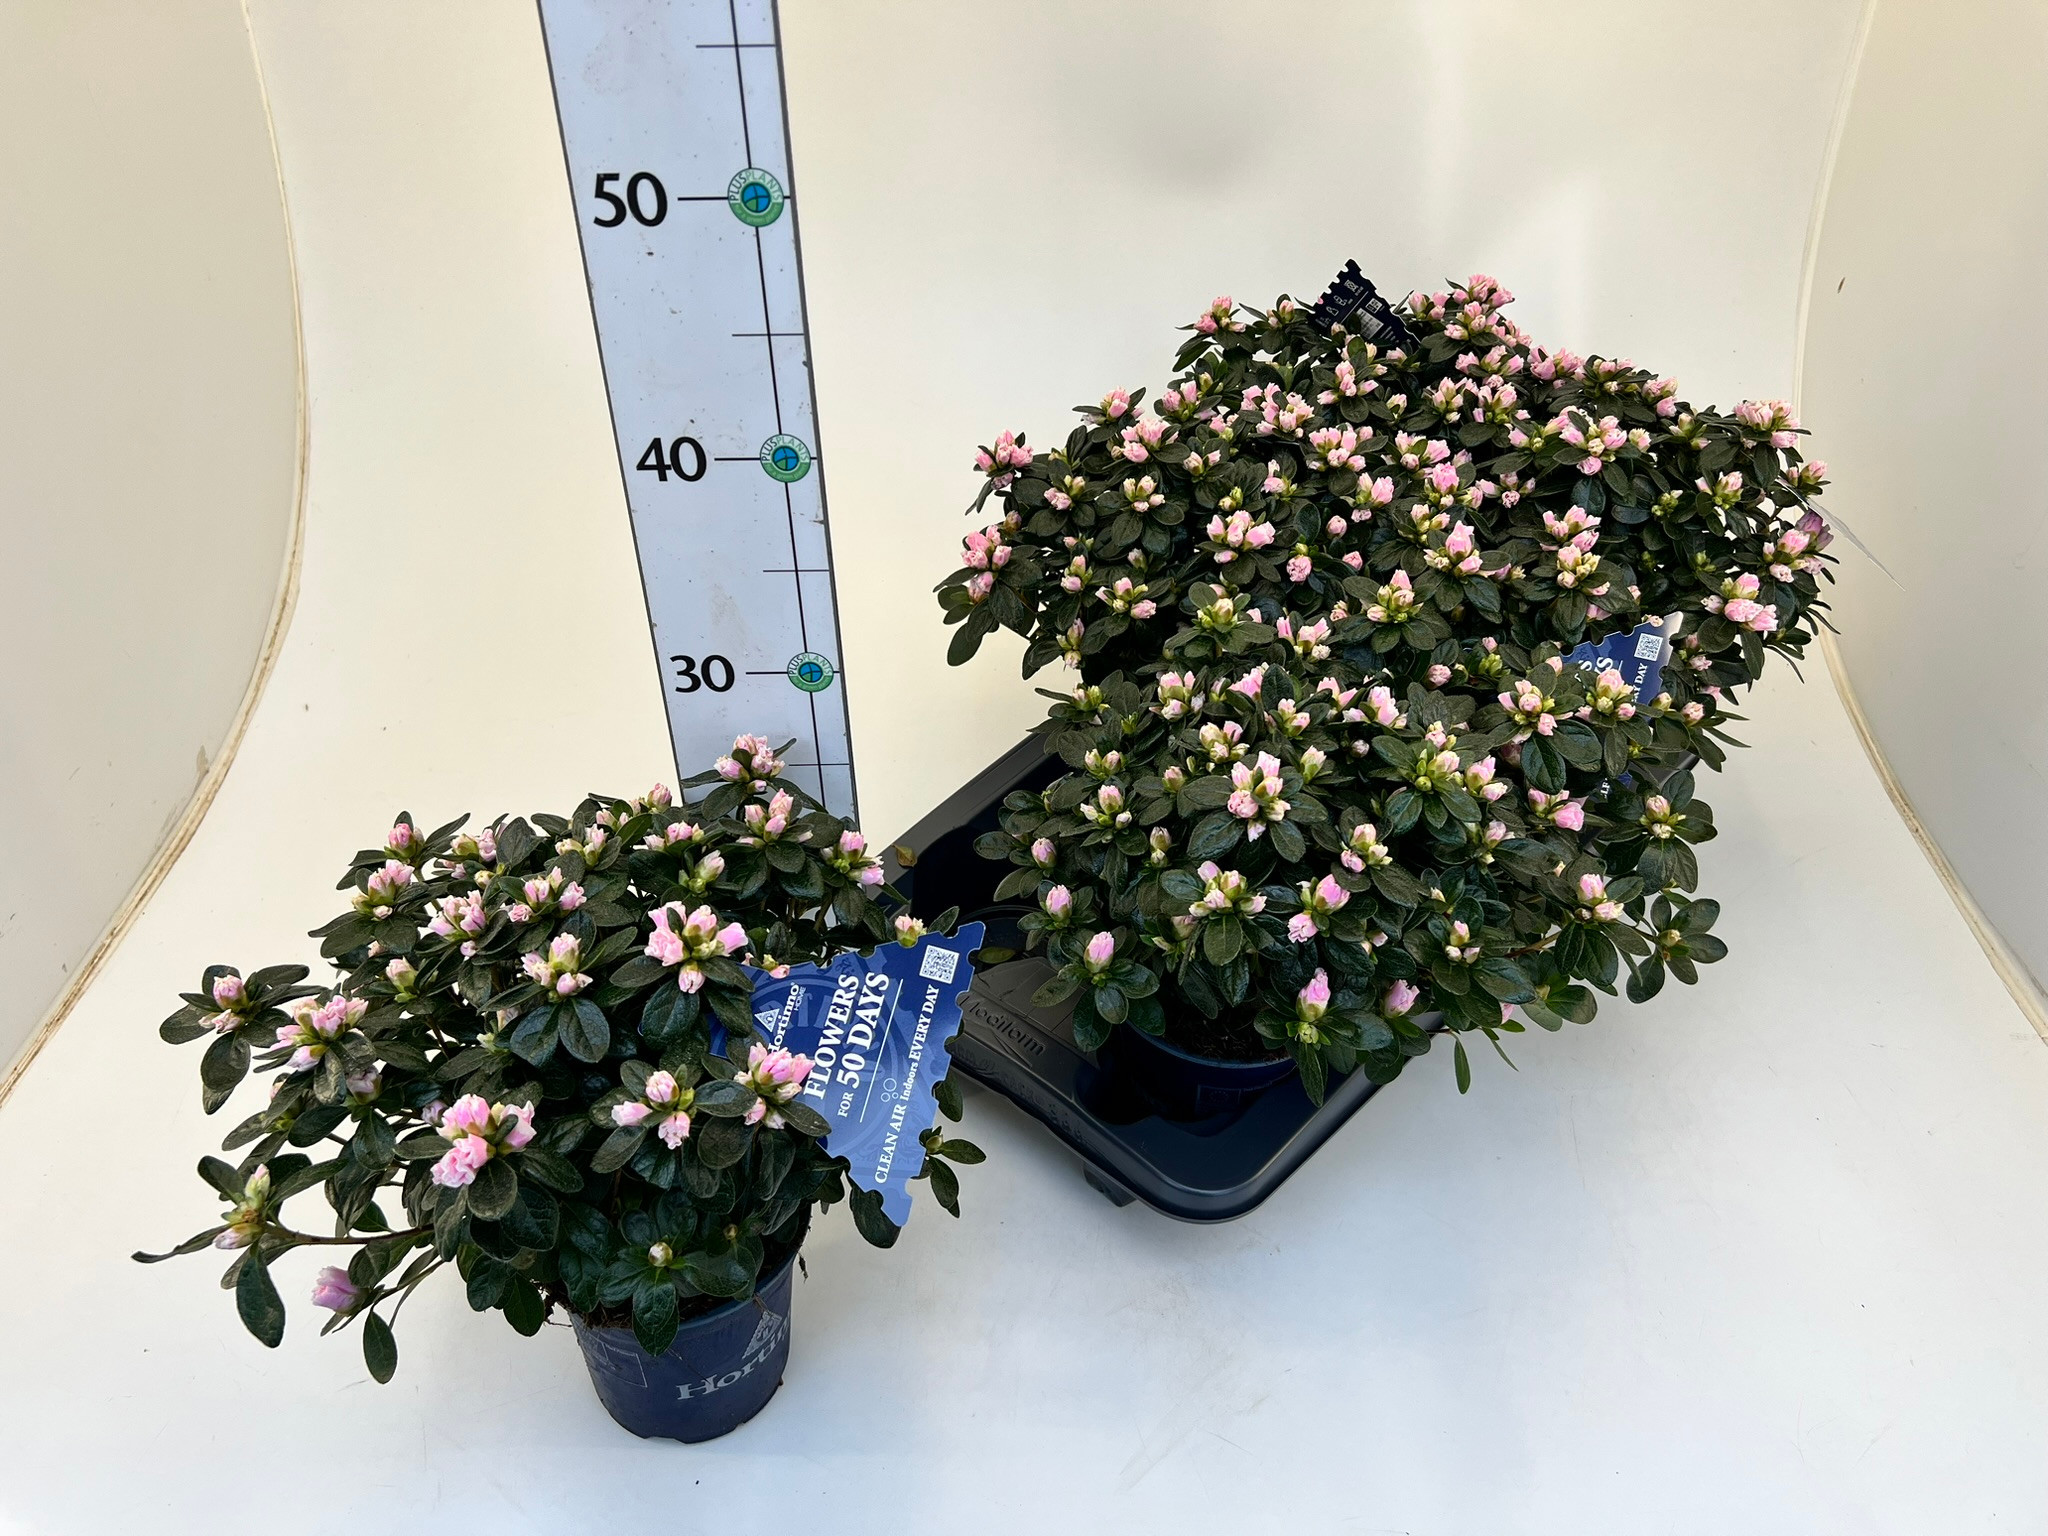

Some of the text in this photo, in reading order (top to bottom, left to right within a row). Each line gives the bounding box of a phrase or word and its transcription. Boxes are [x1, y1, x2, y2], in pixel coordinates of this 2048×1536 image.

[594, 172, 667, 227] 50
[636, 437, 706, 482] 40
[670, 655, 735, 693] 30
[1634, 662, 1648, 684] DAY
[793, 986, 807, 1012] HOME
[803, 974, 860, 1100] FLOWERS
[836, 971, 890, 1118] FOR 50 DAYS
[874, 983, 940, 1184] CLEAN AIR Indoors EVERY DAY
